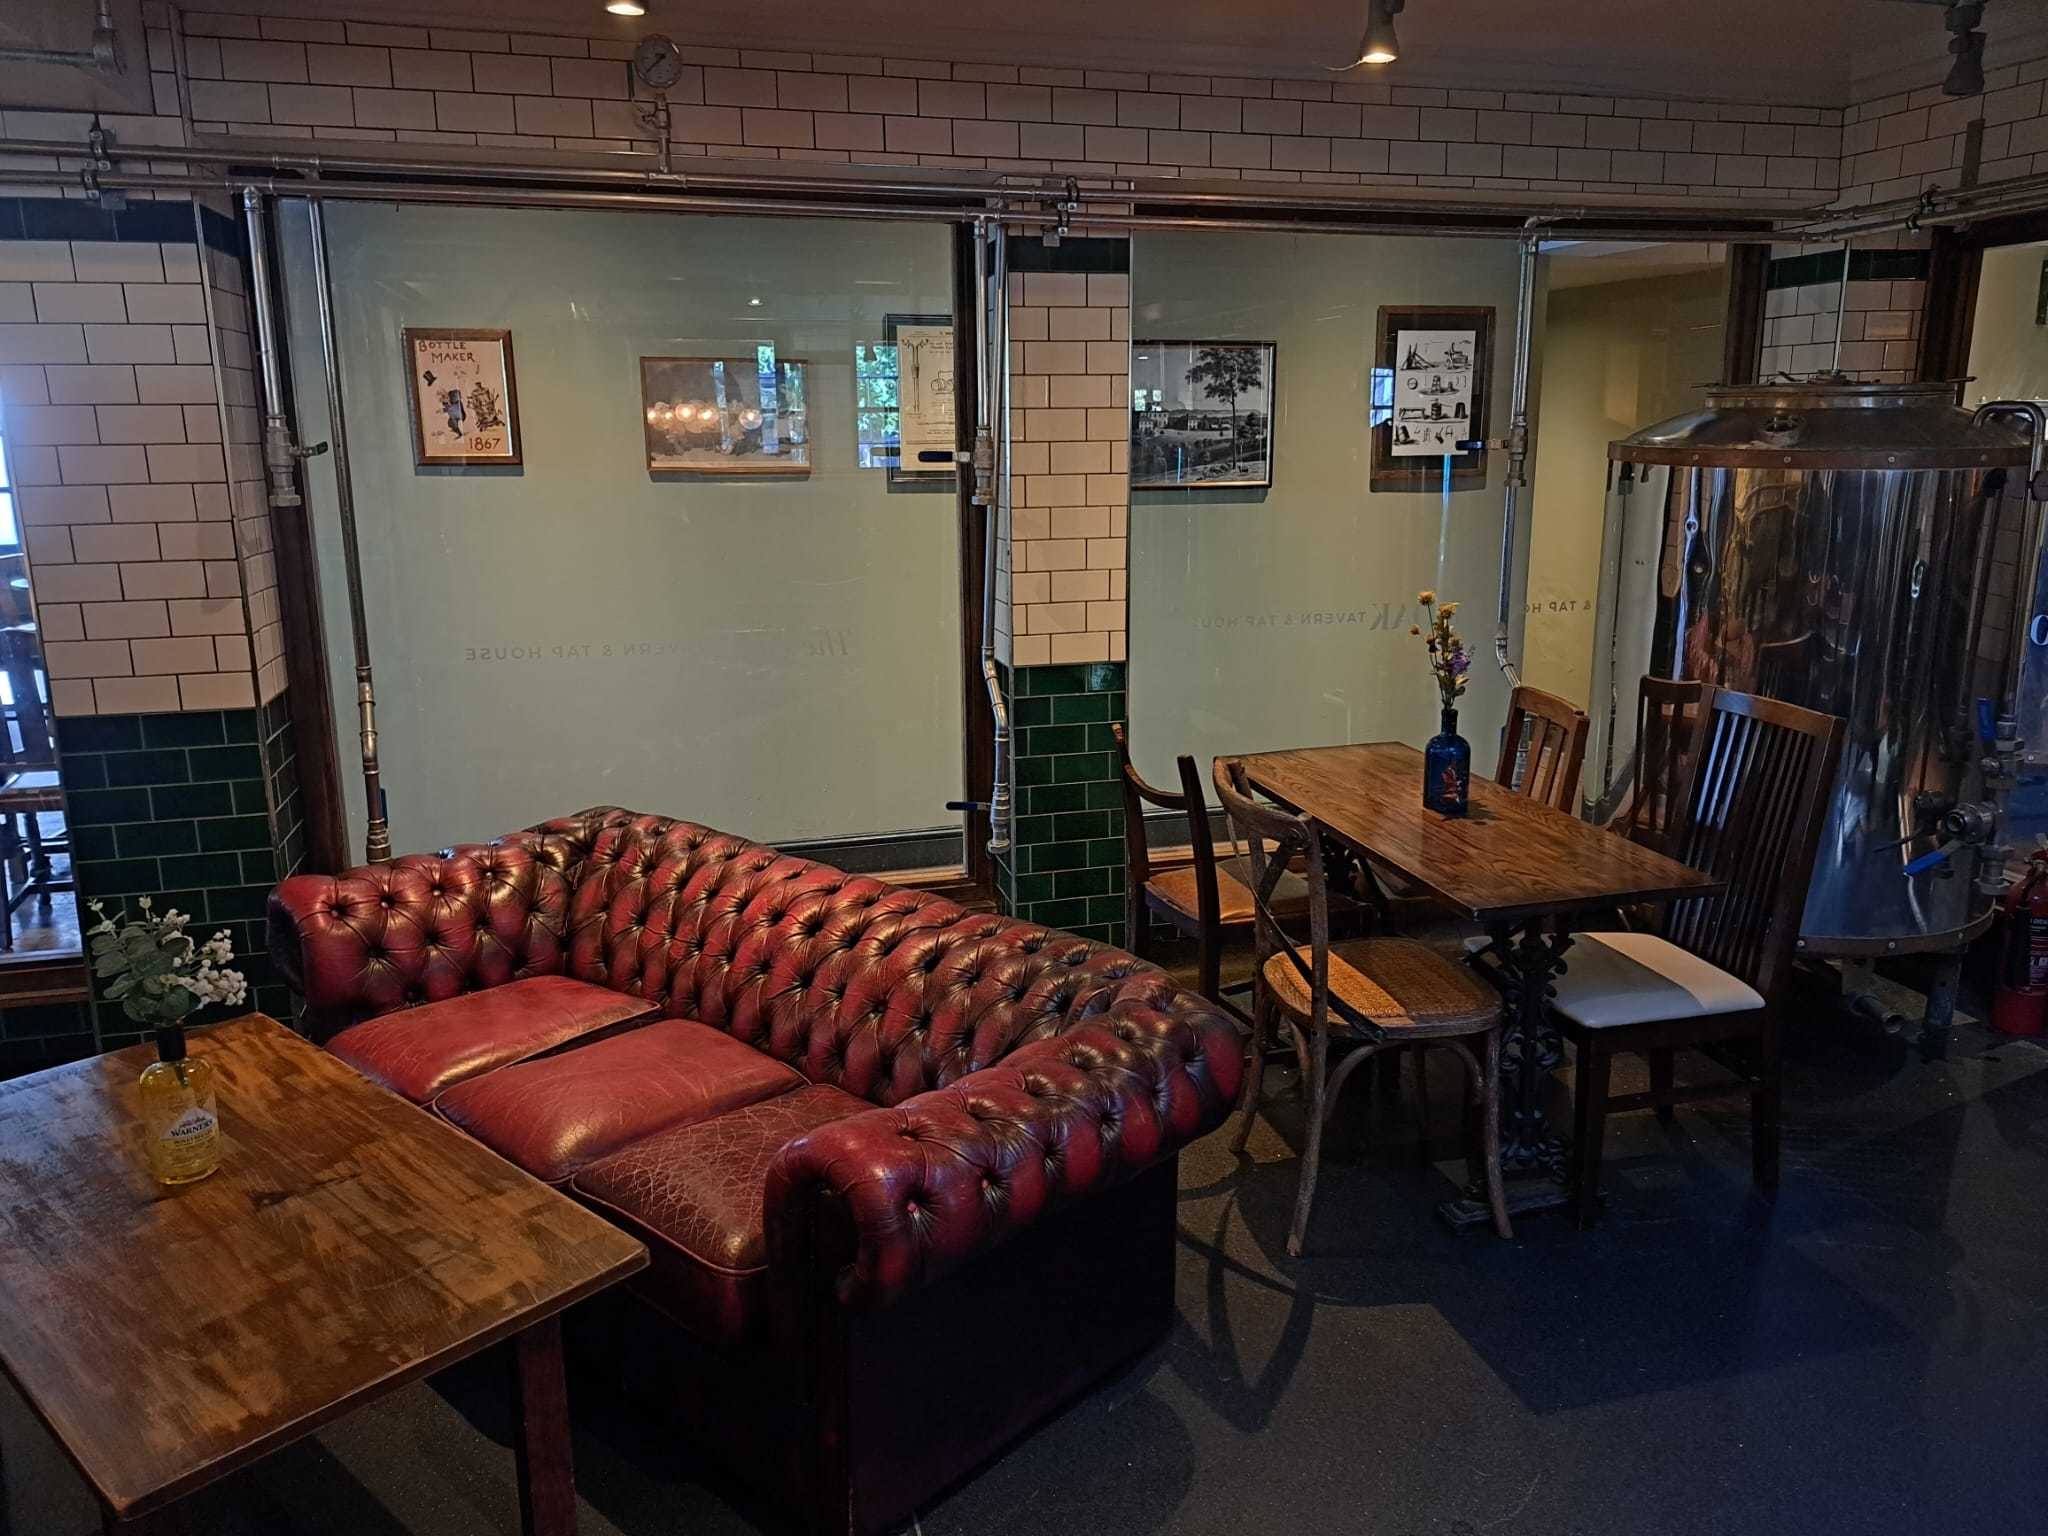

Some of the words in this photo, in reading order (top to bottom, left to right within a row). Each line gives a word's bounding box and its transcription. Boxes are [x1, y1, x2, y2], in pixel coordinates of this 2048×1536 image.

[418, 340, 467, 353] BOTTLE
[431, 352, 475, 363] MAKER
[469, 437, 501, 451] 1867
